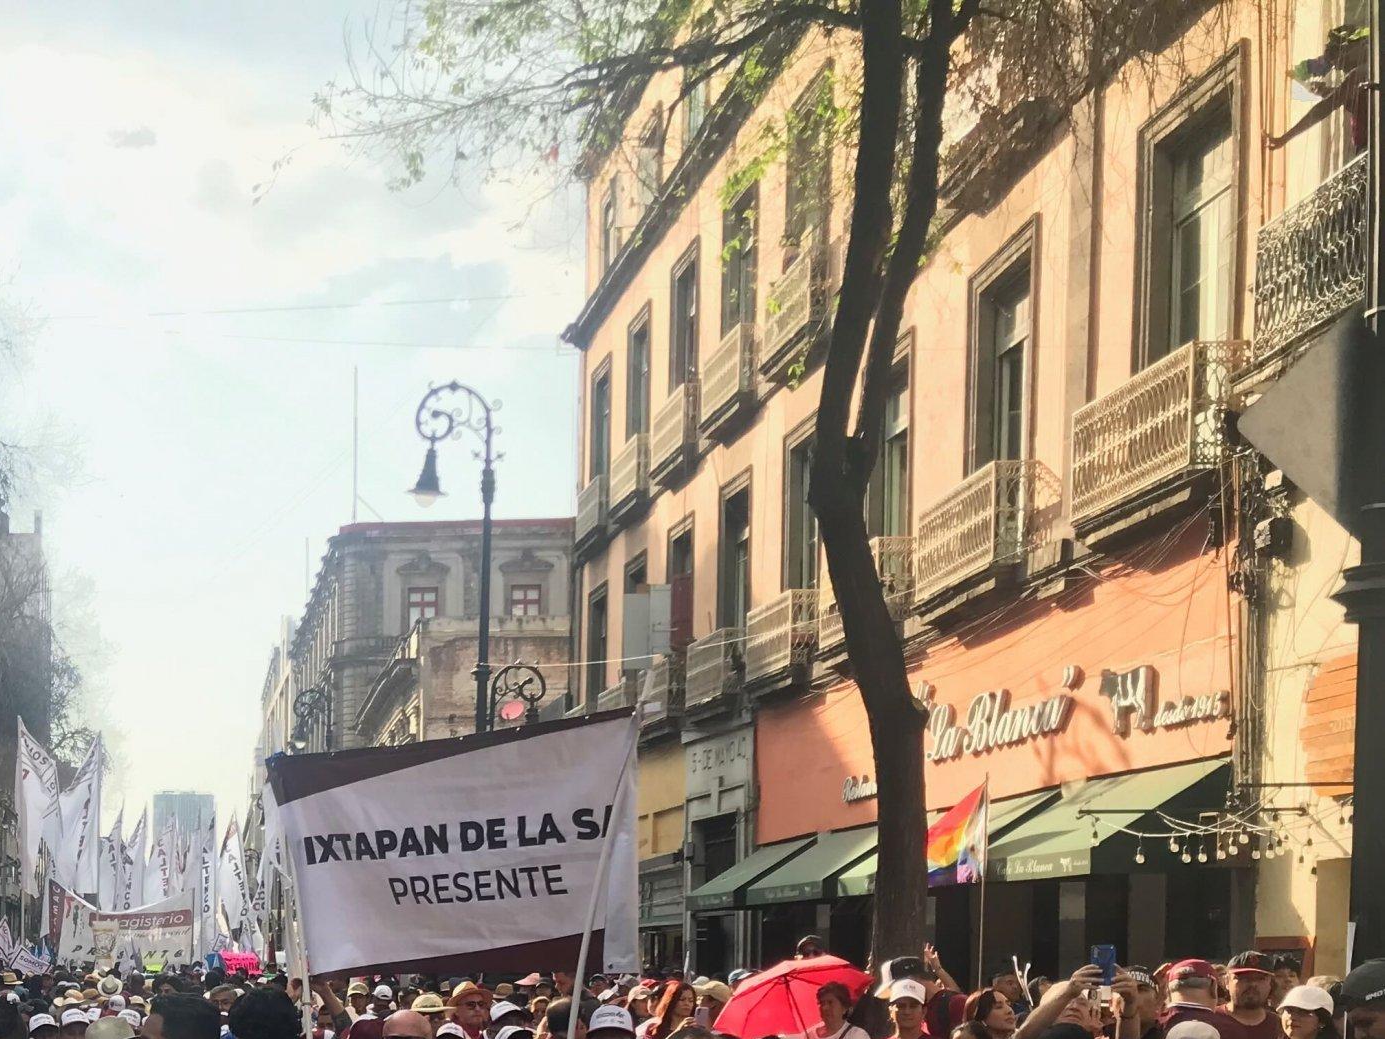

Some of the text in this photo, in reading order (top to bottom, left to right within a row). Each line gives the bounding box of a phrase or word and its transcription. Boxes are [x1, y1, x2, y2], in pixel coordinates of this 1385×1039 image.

[304, 823, 449, 865] IXTAPAN
[459, 818, 507, 851] DE
[517, 813, 567, 847] LA
[388, 864, 568, 905] PRESENTE
